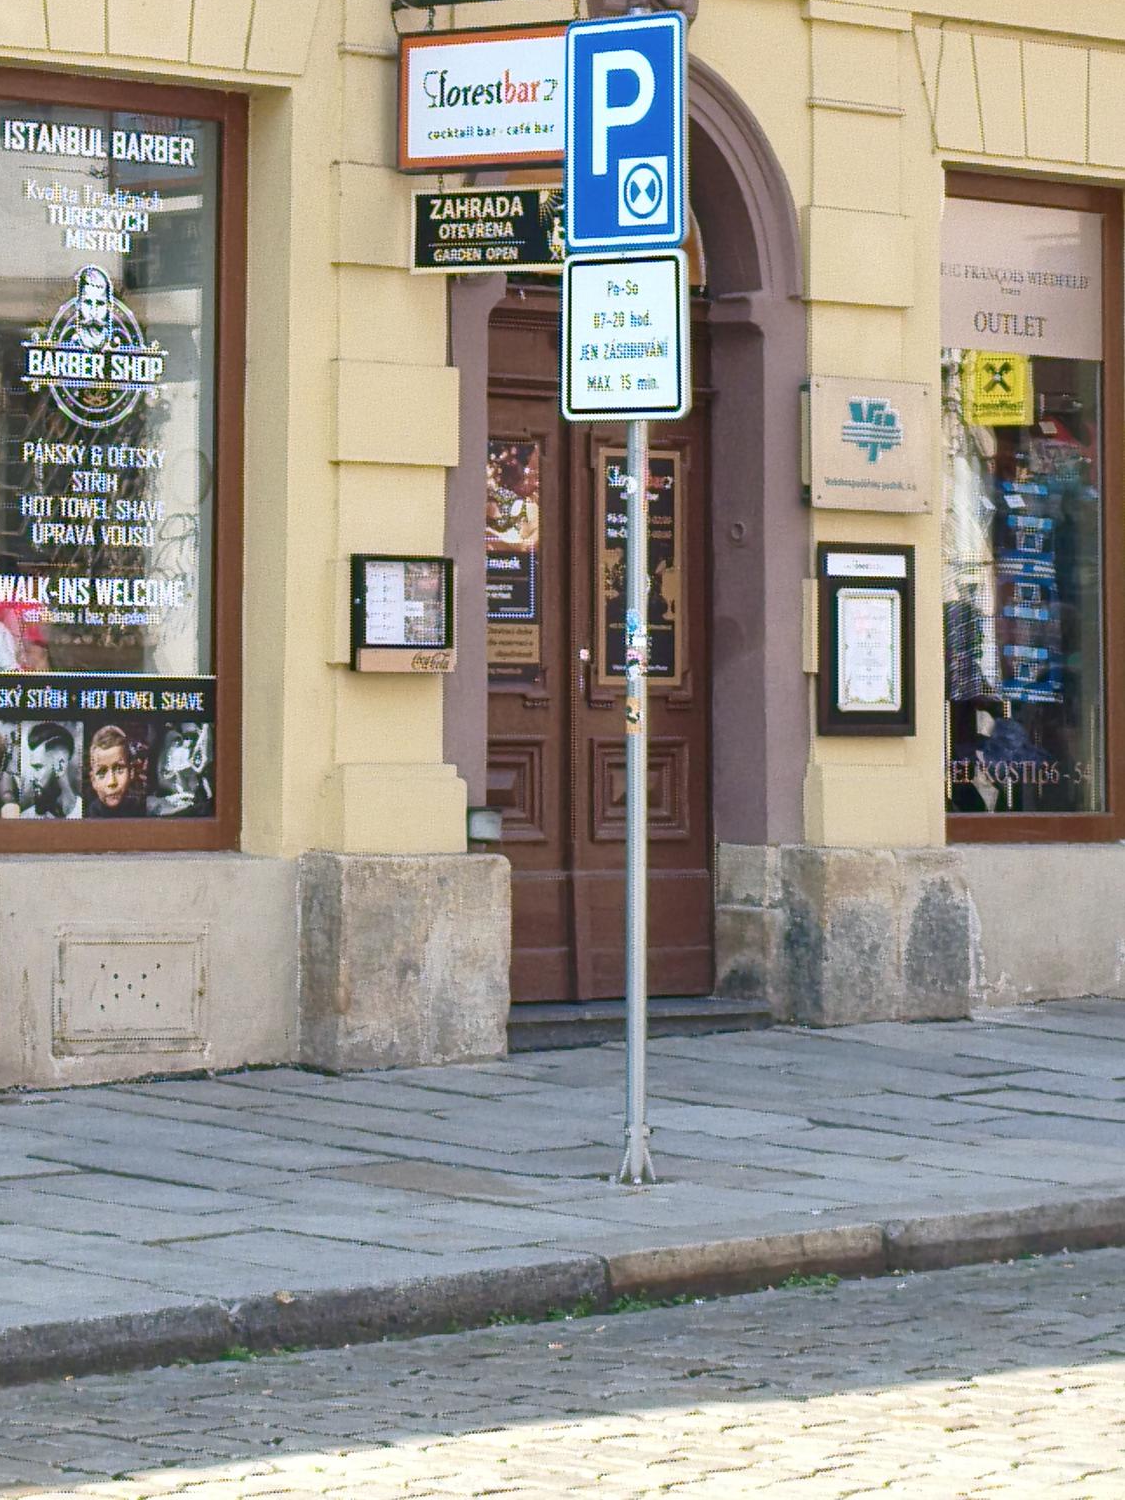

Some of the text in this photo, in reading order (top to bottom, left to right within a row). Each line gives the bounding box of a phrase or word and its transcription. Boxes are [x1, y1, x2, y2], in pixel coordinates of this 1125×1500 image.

[592, 49, 655, 176] P
[3, 120, 195, 167] ISTANBUL BARBER
[427, 120, 555, 141] cocktail bar café bar
[25, 179, 79, 201] Kvalita
[428, 195, 525, 220] ZAHRADA
[438, 219, 515, 240] OTEVŘENA
[432, 246, 519, 262] GARDEN OPEN
[974, 310, 1048, 338] OUTLET
[28, 350, 164, 381] BARBER SHOP
[579, 343, 599, 362] JEN
[22, 438, 86, 465] PÁNSKÝ
[90, 445, 102, 466] &
[21, 495, 166, 522] HOT TOWEL SHAVE
[95, 577, 185, 607] WELCOME
[26, 684, 68, 709] STŘIH
[81, 689, 109, 709] HOT
[112, 689, 157, 711] TOWEL
[161, 690, 205, 711] SHAVE
[952, 757, 1036, 784] ELIKOSTI
